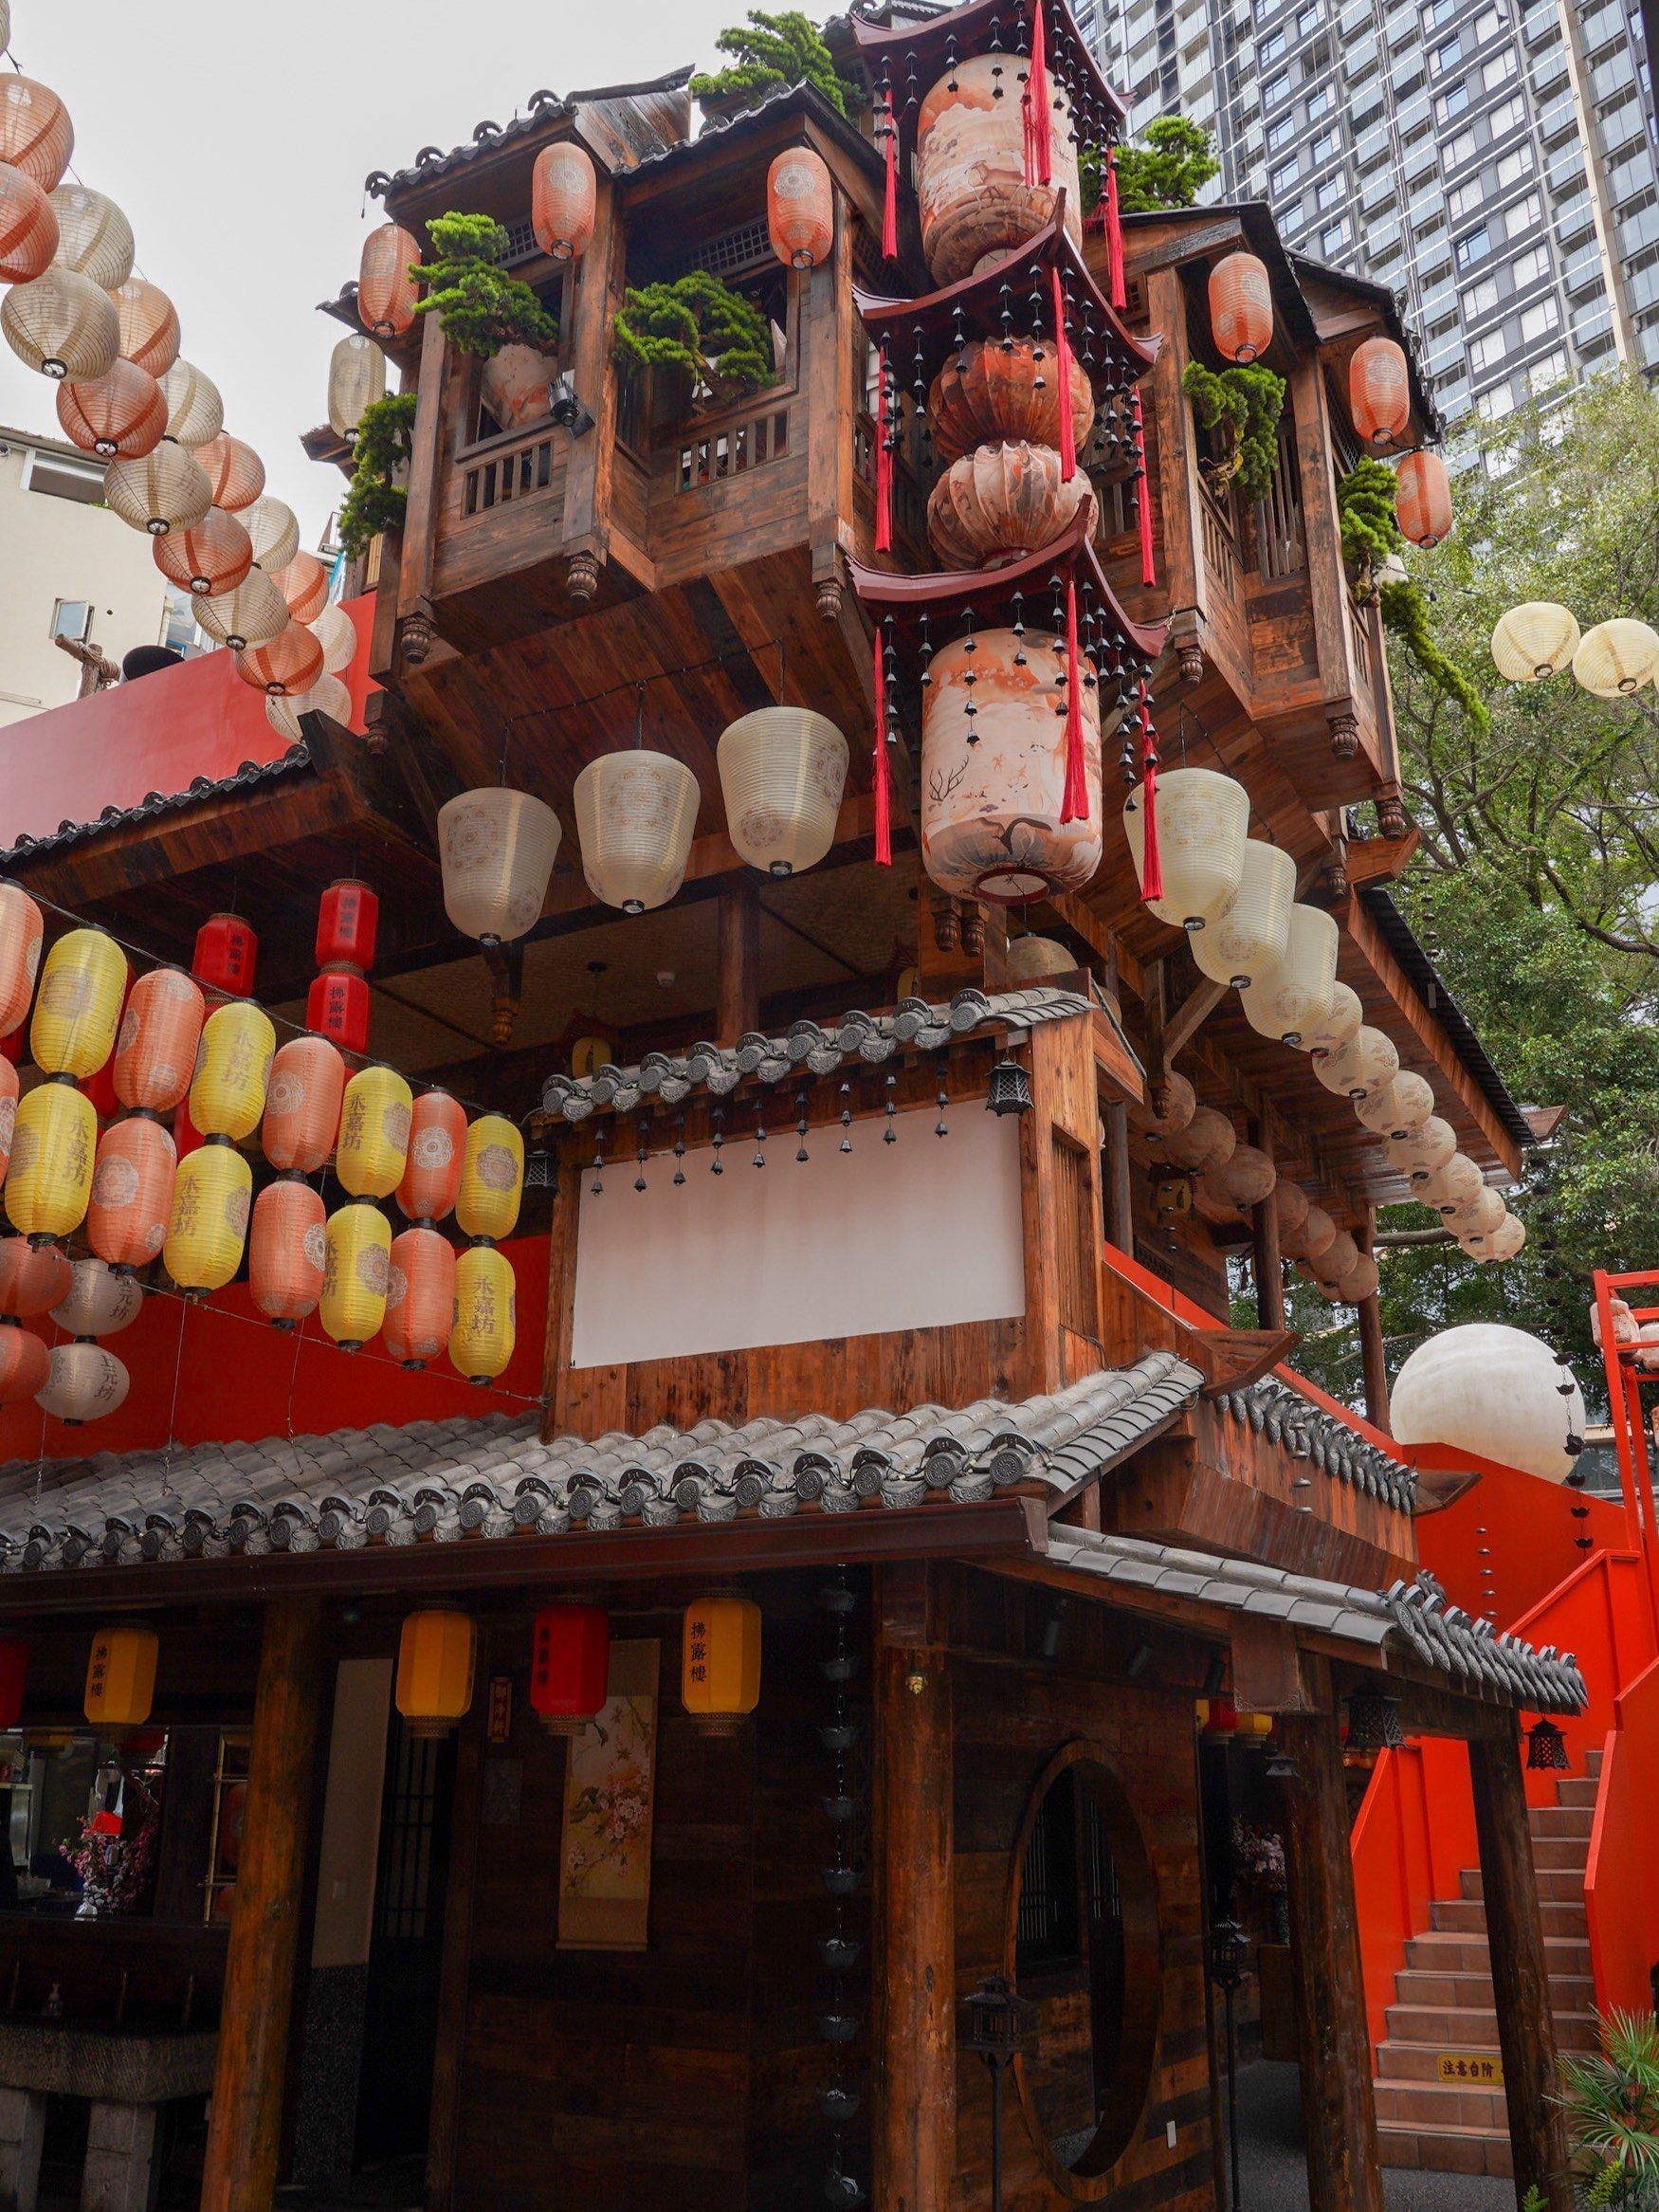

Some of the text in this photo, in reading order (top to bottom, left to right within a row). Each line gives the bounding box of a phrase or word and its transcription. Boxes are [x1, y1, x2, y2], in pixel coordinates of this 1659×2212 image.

[63, 1116, 88, 1187] 永嘉坊
[343, 1092, 366, 1151] 永嘉坊
[173, 1175, 201, 1236] 永嘉坊
[473, 1275, 495, 1335] 永嘉坊
[95, 1354, 118, 1401] 上元坊
[691, 1621, 707, 1683] 拂露樓
[1443, 2060, 1494, 2077] 注意台阶
